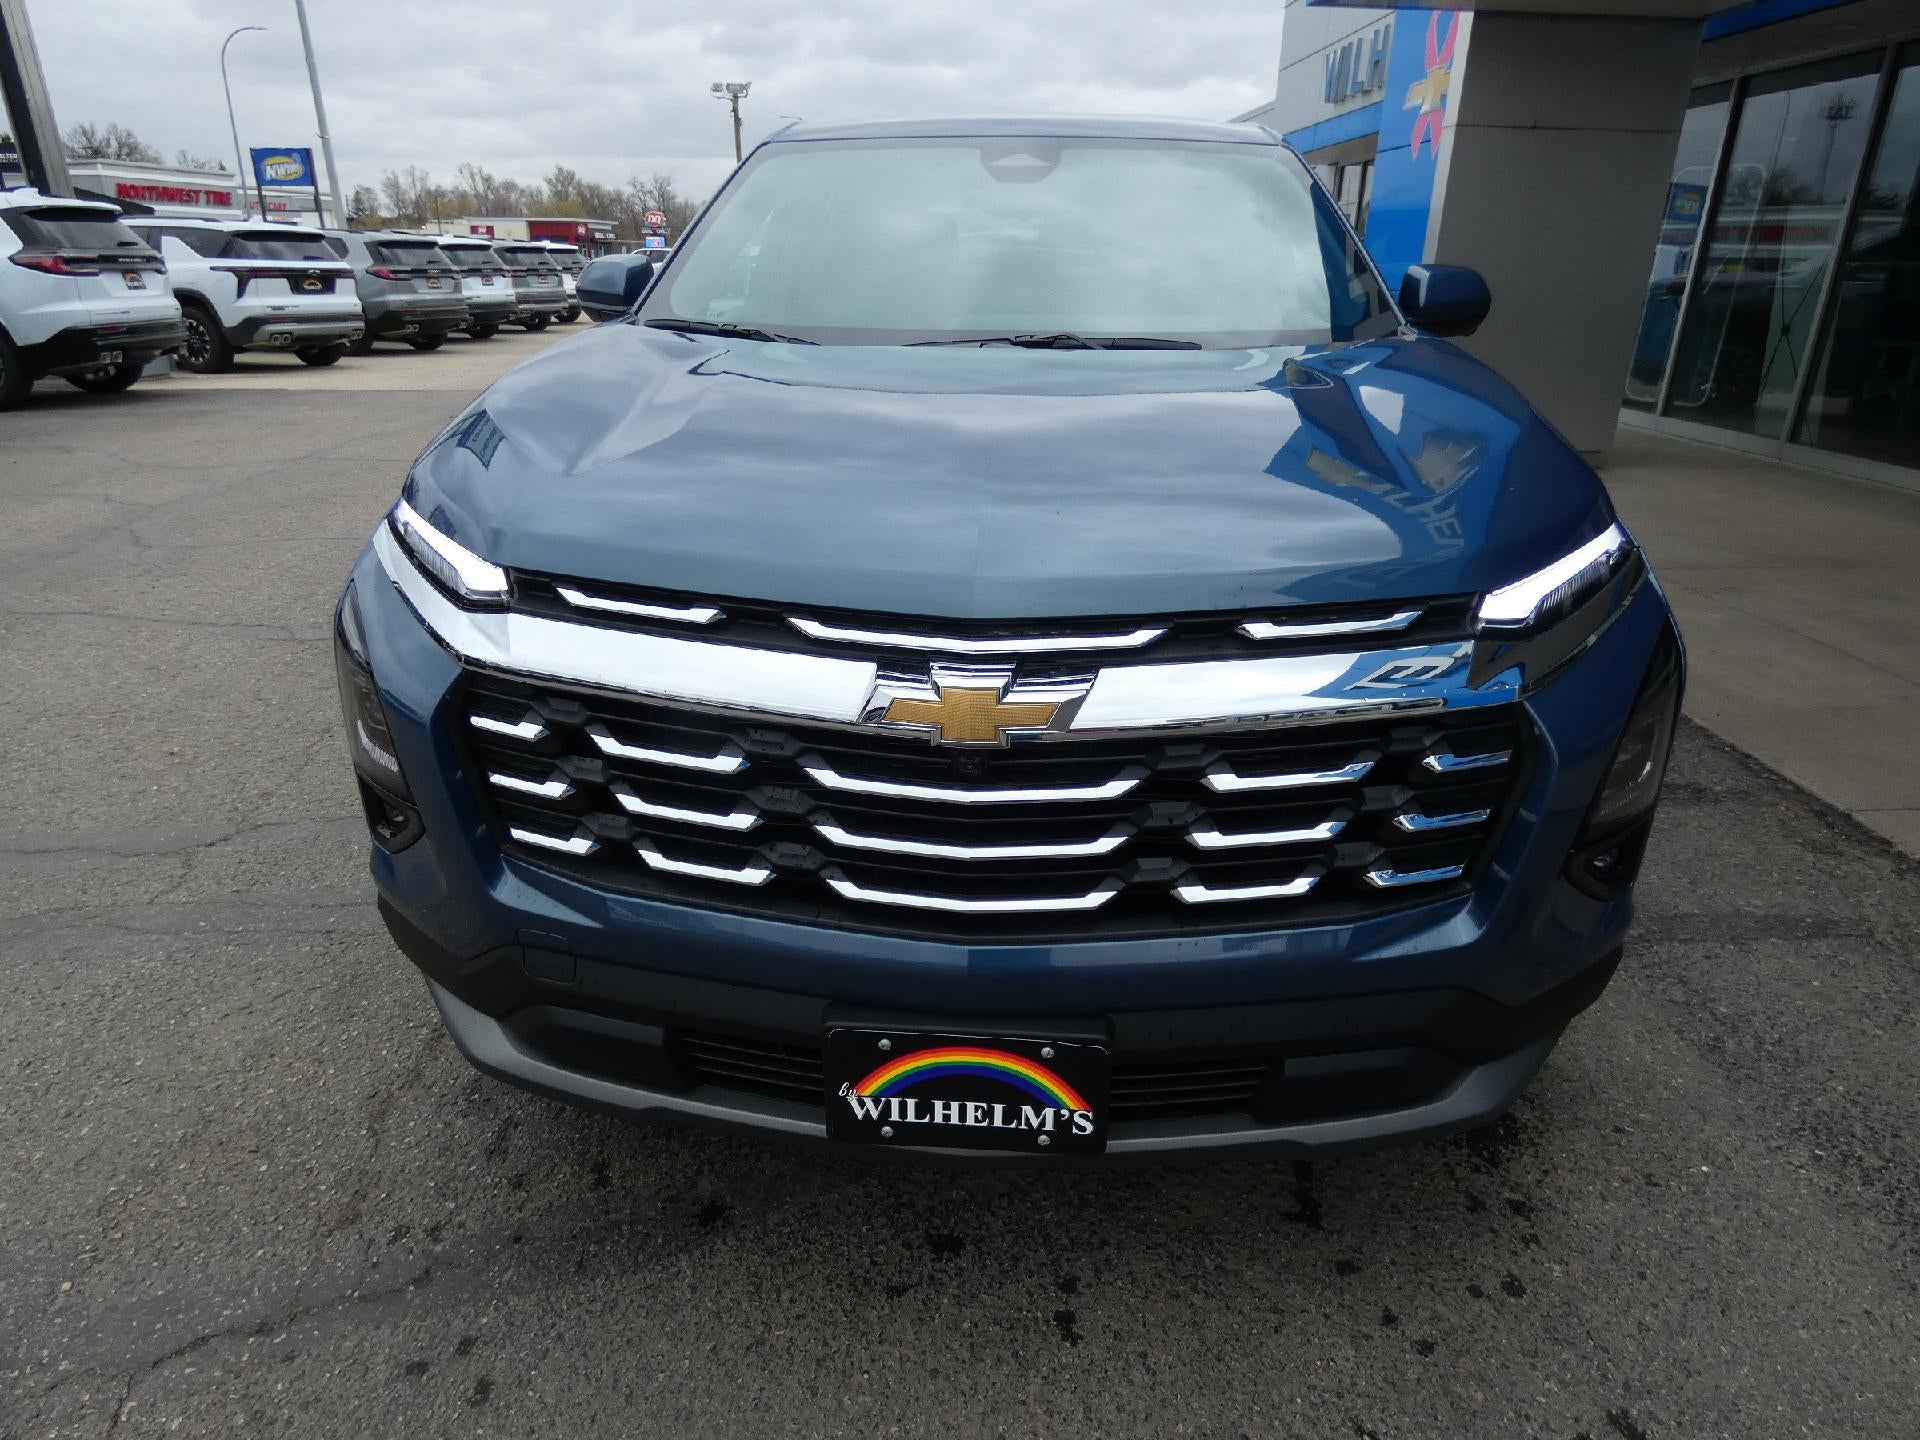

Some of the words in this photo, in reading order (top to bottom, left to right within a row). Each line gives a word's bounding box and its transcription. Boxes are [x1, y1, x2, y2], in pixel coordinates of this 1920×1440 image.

[116, 183, 202, 204] NORTHWEST
[205, 190, 232, 206] TIRE
[839, 1082, 859, 1101] by
[849, 1097, 1095, 1135] WILHELM'S
